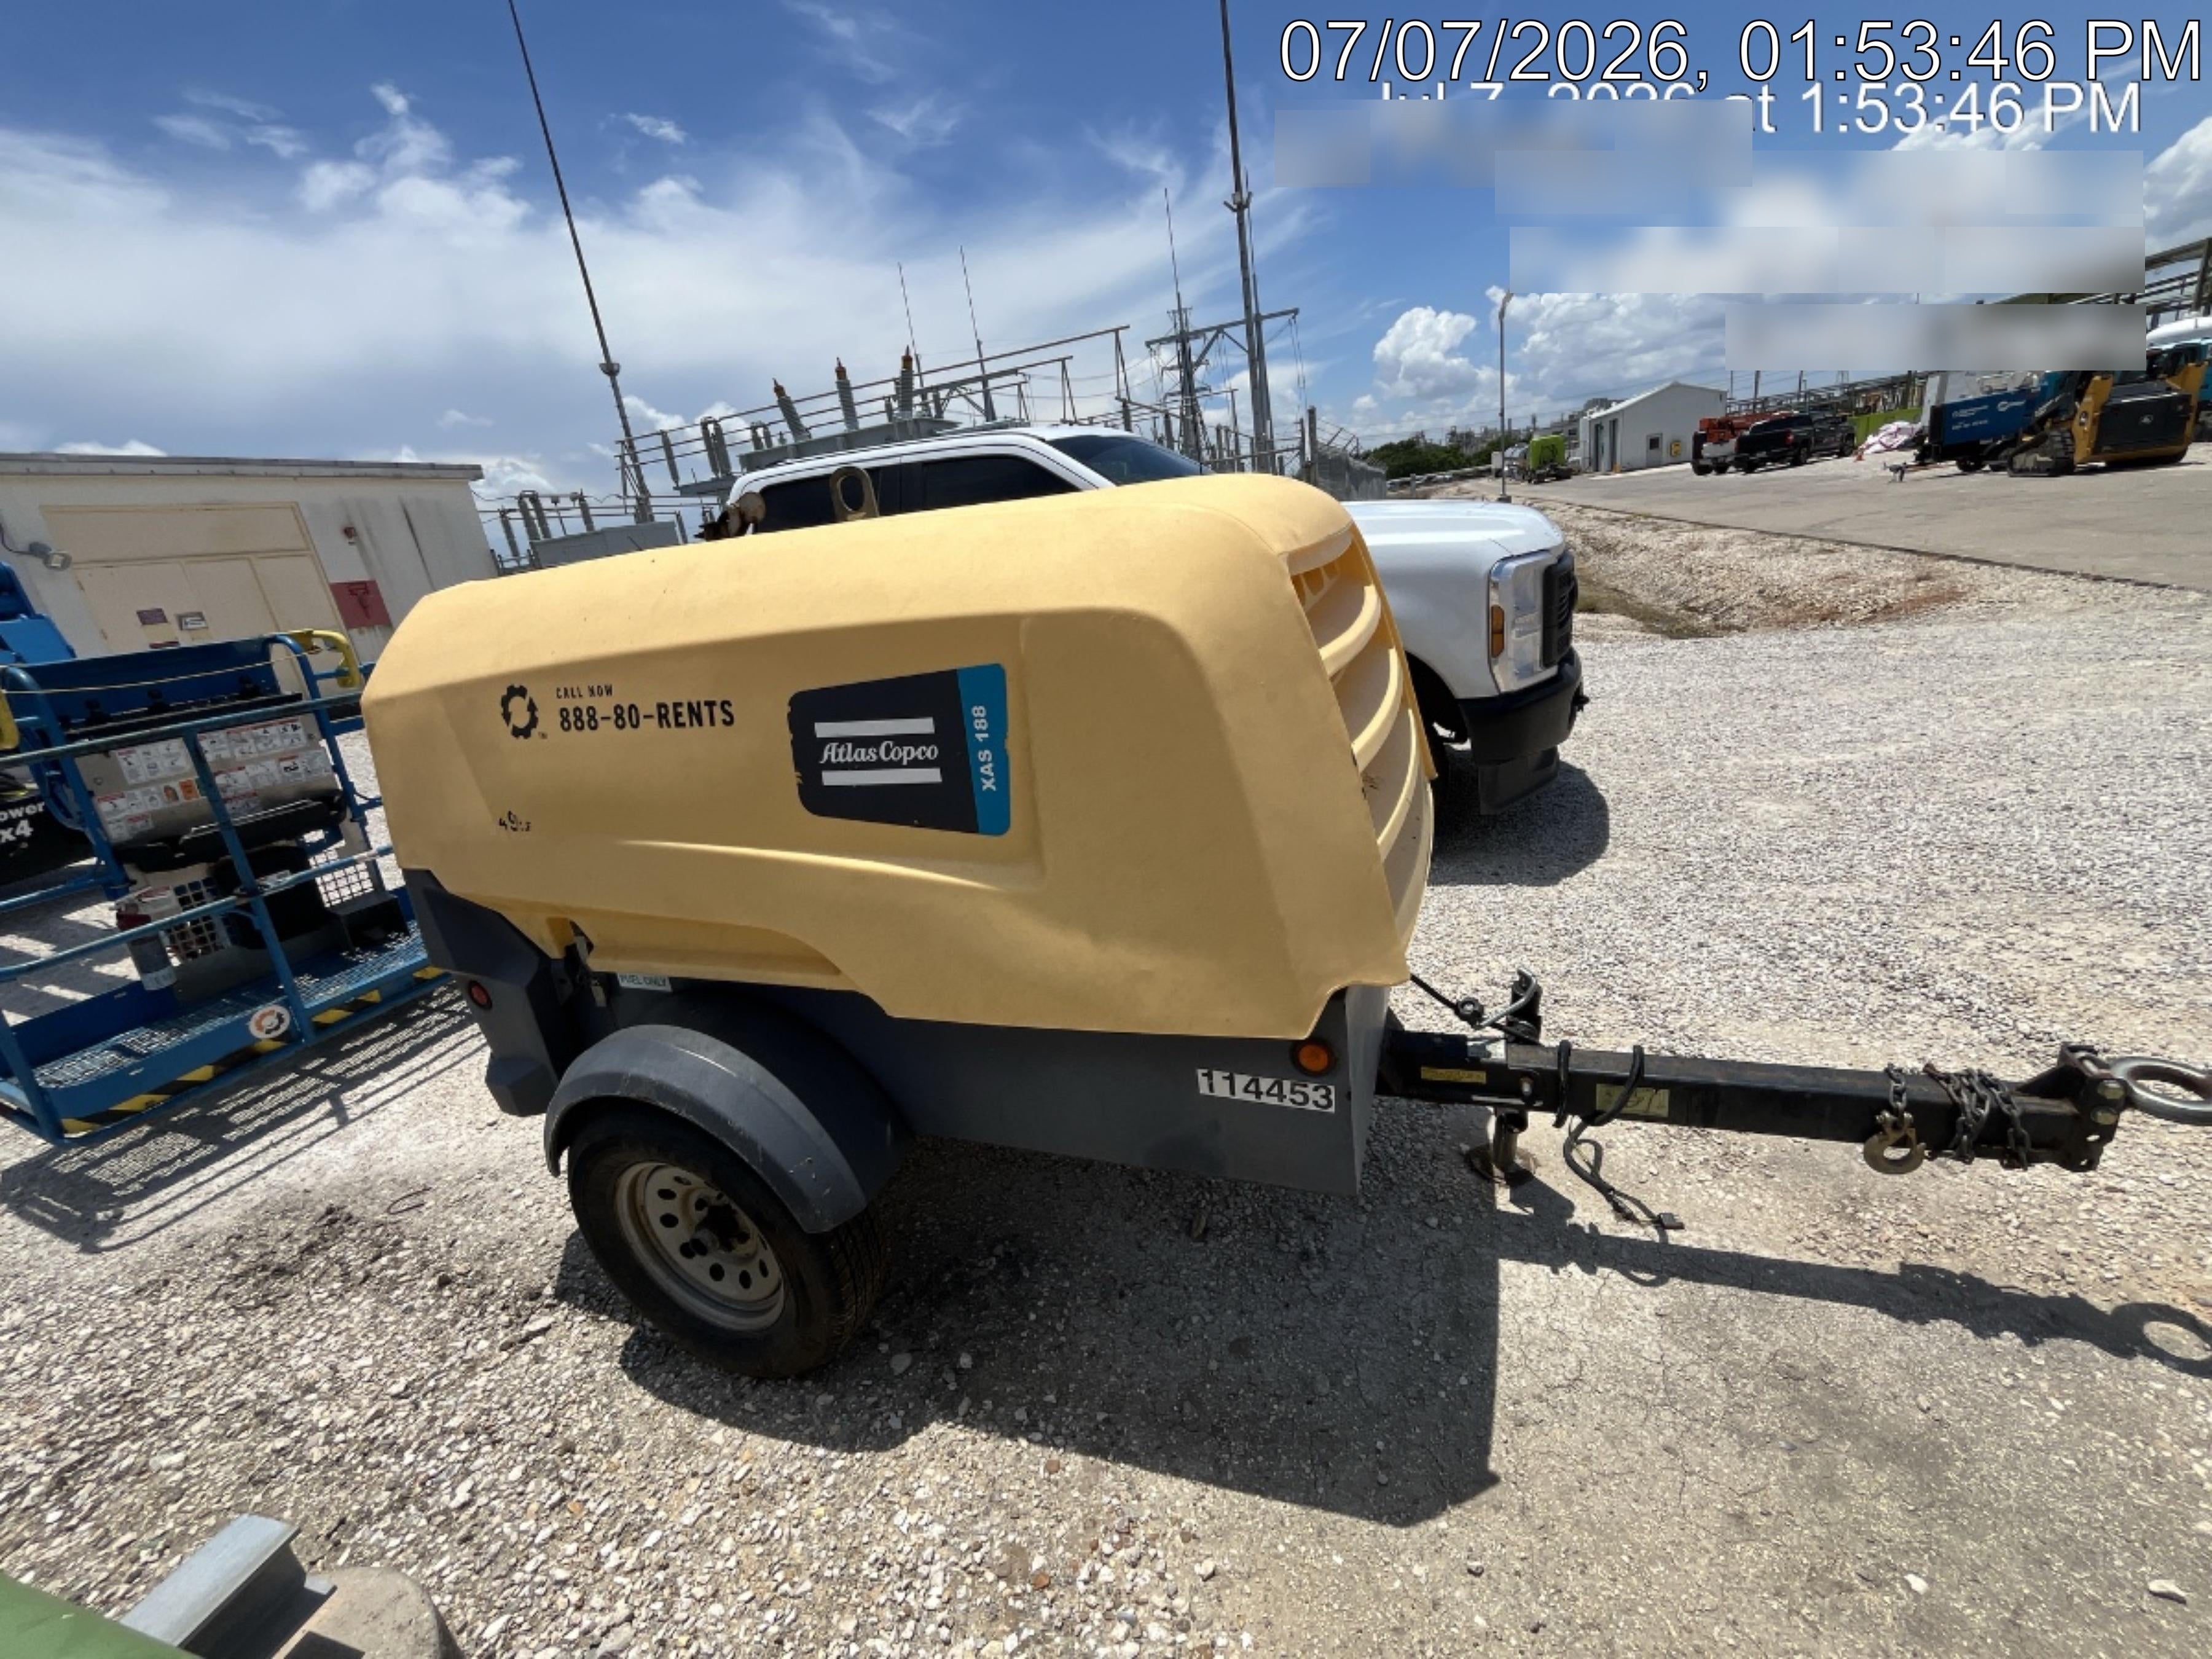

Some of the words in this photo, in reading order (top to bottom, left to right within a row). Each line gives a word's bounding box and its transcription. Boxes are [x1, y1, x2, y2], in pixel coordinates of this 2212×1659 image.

[556, 687, 583, 699] CALL
[587, 684, 613, 697] NOW
[560, 699, 734, 732] 888-80-RENTS
[971, 705, 989, 742] 188
[978, 750, 997, 792] XAS
[1201, 1069, 1333, 1110] 114453
